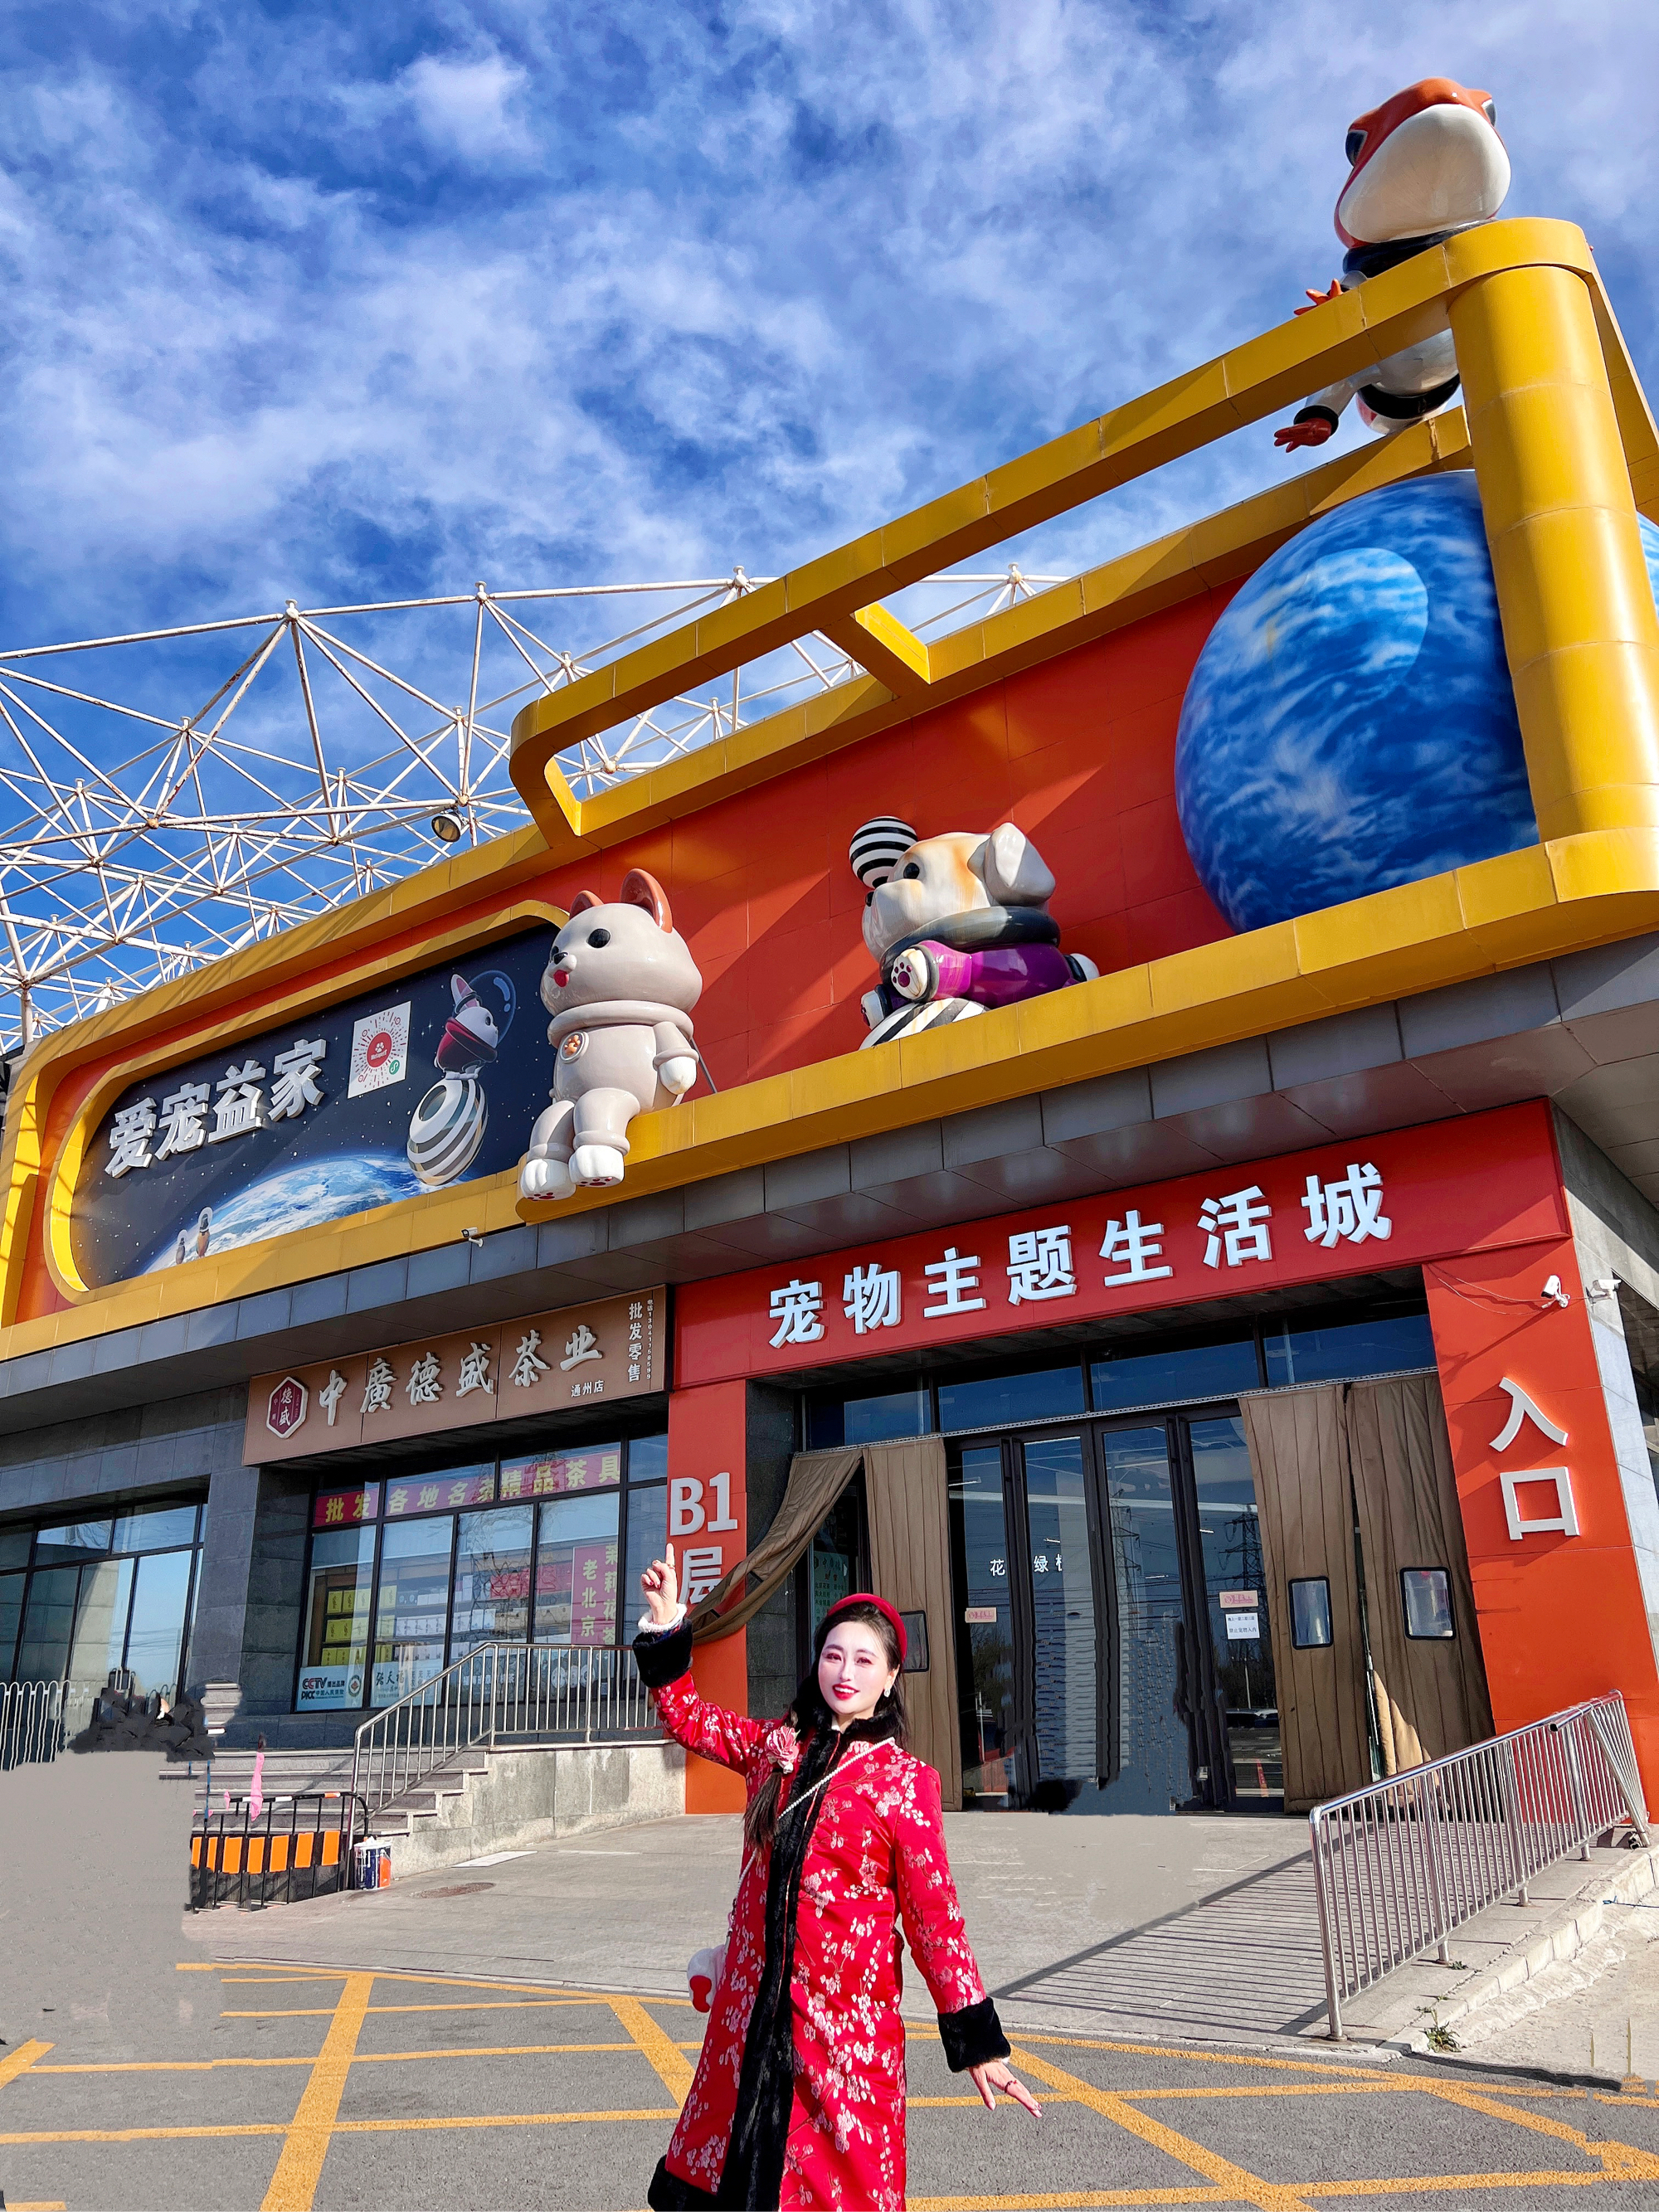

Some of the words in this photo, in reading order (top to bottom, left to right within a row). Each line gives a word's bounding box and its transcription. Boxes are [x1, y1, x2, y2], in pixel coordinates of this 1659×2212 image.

[105, 1038, 327, 1179] 爱宠益家
[767, 1161, 1393, 1348] 宠物主题生活城
[627, 1300, 643, 1383] 批发零售
[571, 1379, 605, 1398] 通州店
[1489, 1376, 1581, 1541] 入口
[669, 1471, 738, 1536] B1
[581, 1559, 598, 1638] 老北京
[602, 1544, 618, 1646] 茉莉花茶
[679, 1546, 722, 1604] 层
[302, 1676, 328, 1690] CCTV
